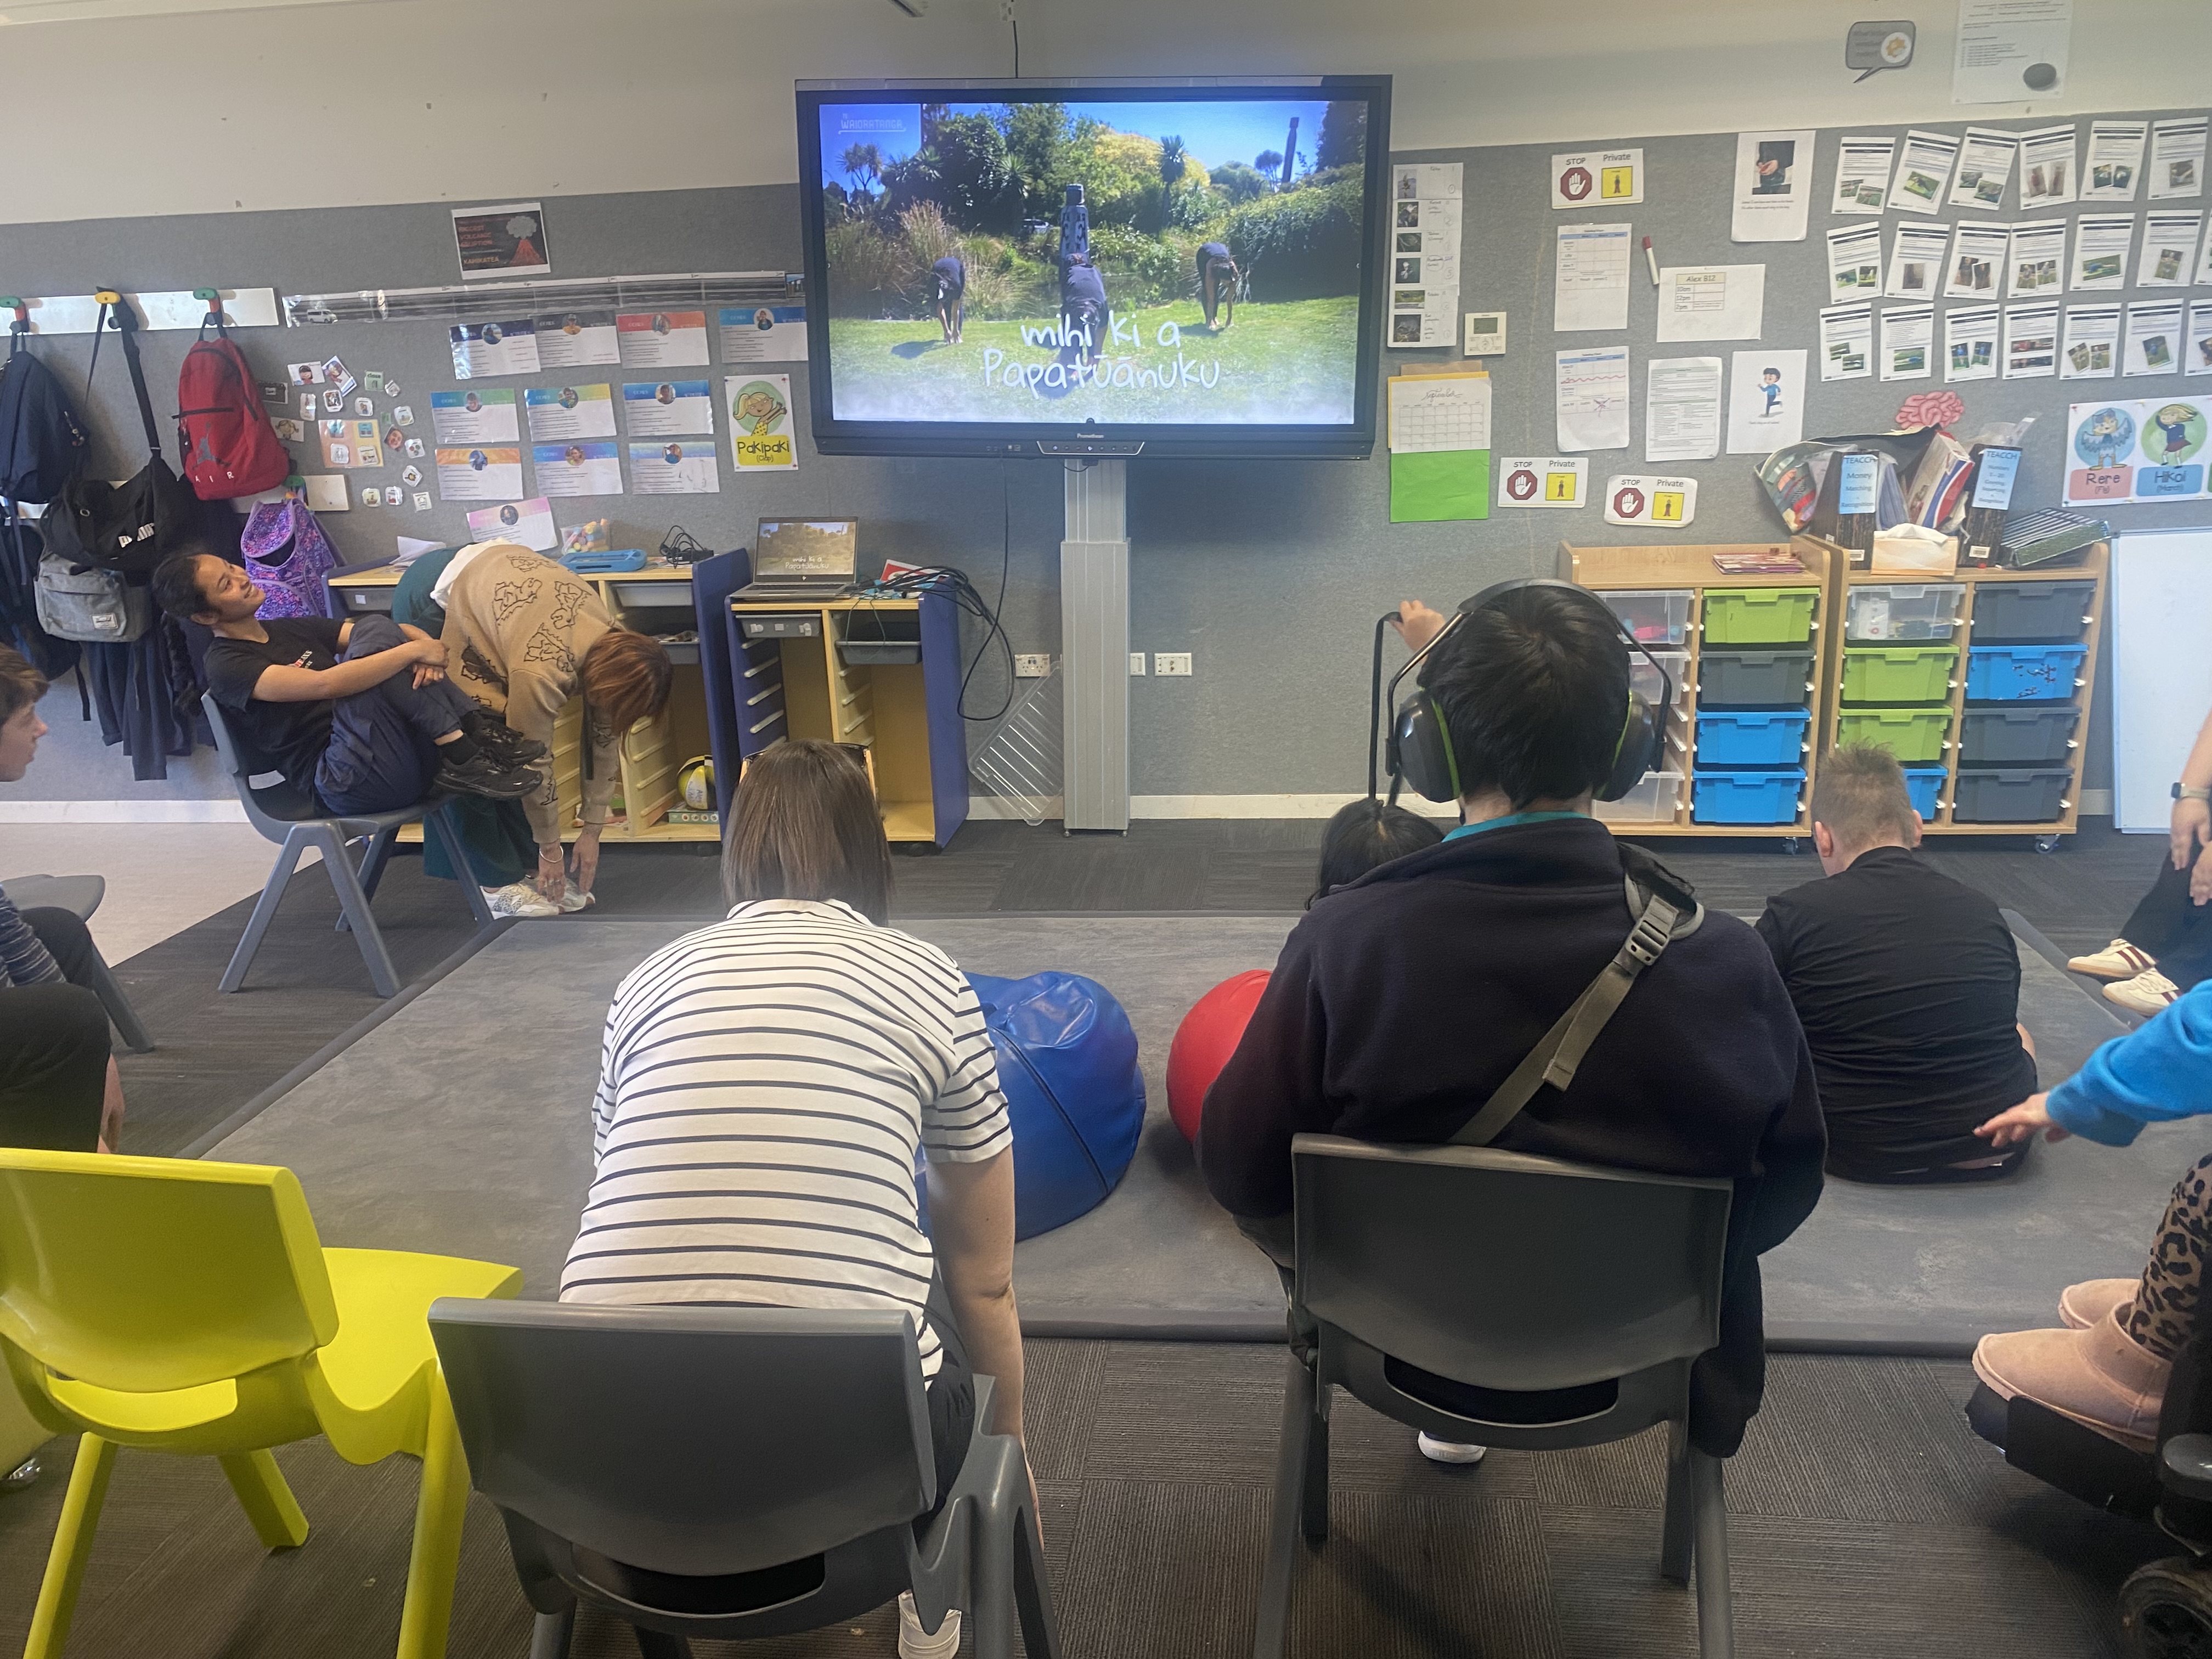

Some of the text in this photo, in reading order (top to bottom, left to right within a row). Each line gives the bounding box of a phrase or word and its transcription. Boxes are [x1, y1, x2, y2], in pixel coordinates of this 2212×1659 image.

[1603, 153, 1632, 161] Private
[1020, 310, 1181, 347] mihi ki a
[983, 348, 1220, 399] Papatūānuku
[737, 440, 789, 458] Pakipaki
[1987, 450, 2018, 459] TEACCH
[195, 471, 234, 483] AIR
[1657, 479, 1684, 487] Private
[2086, 473, 2120, 485] Rere
